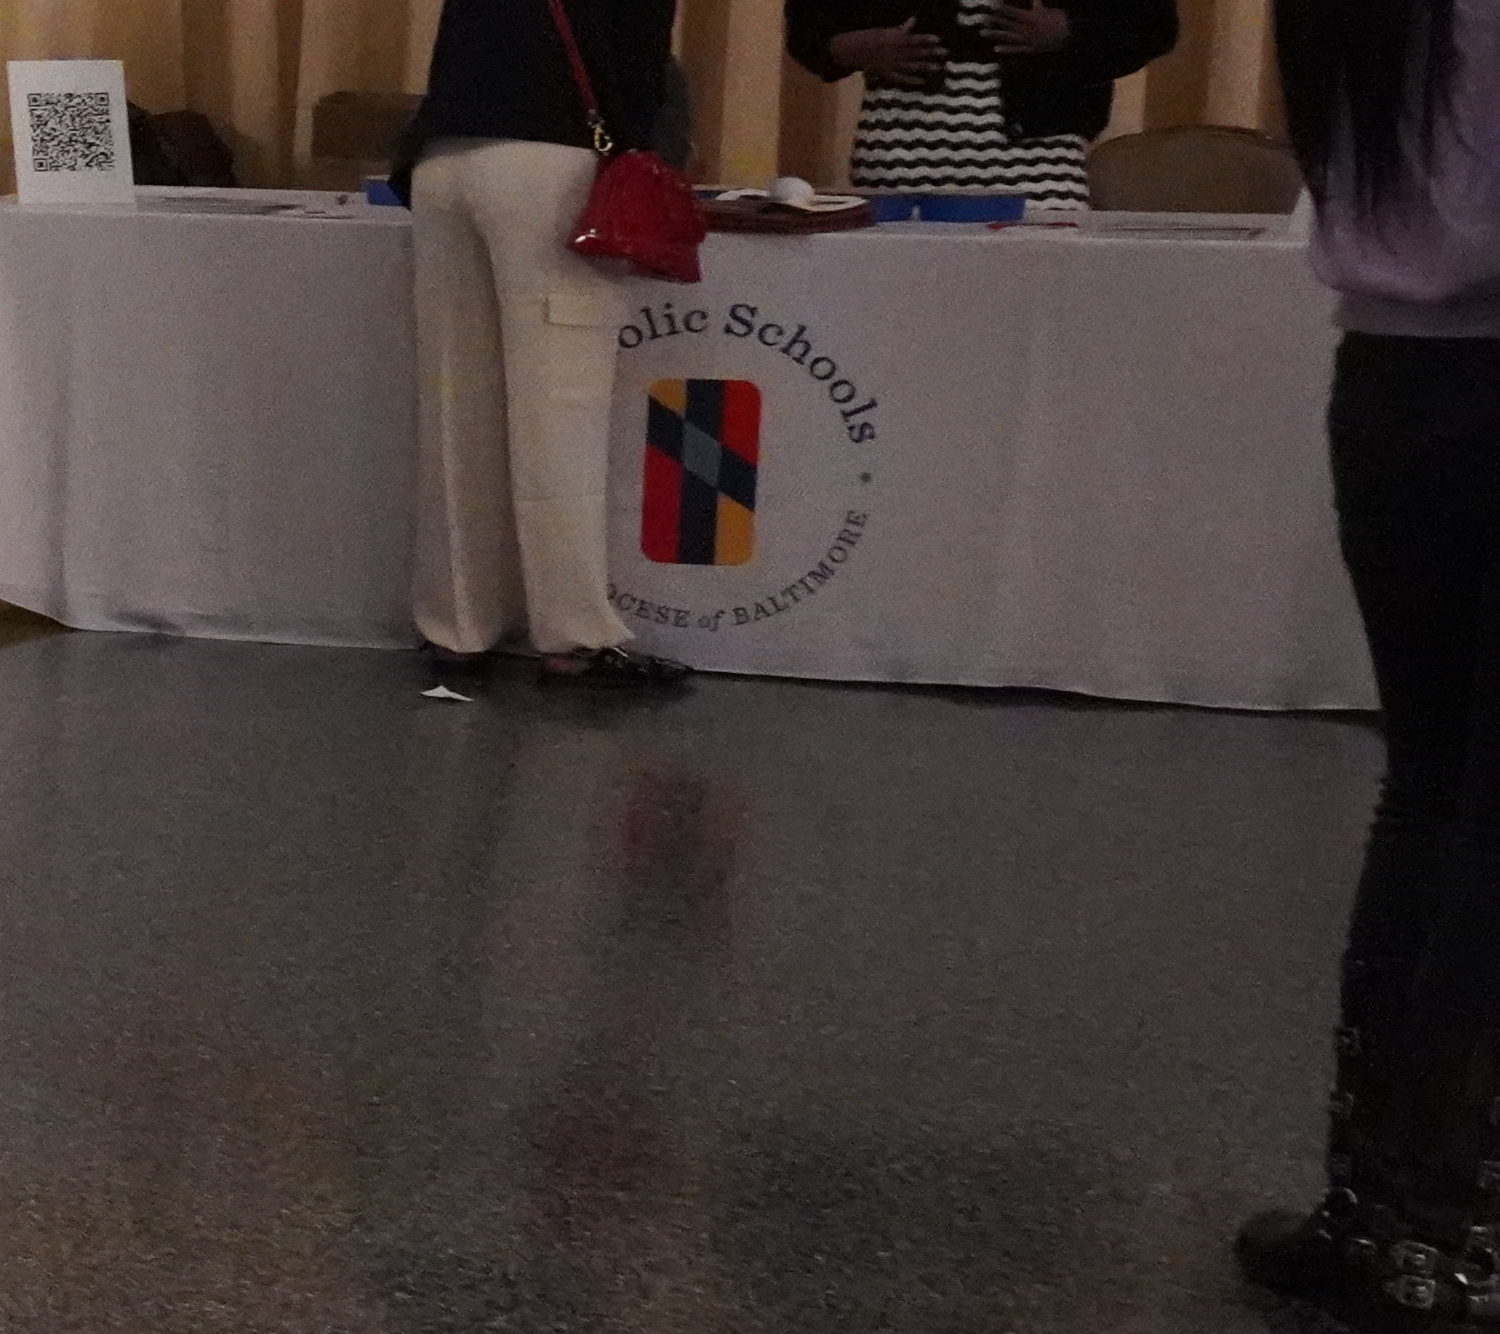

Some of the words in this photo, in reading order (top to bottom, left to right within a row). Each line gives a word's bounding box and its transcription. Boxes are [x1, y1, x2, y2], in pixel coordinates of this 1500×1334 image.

[617, 303, 708, 350] olic
[723, 303, 877, 445] Schools
[696, 609, 724, 632] of
[731, 510, 870, 626] BALTIMORE
